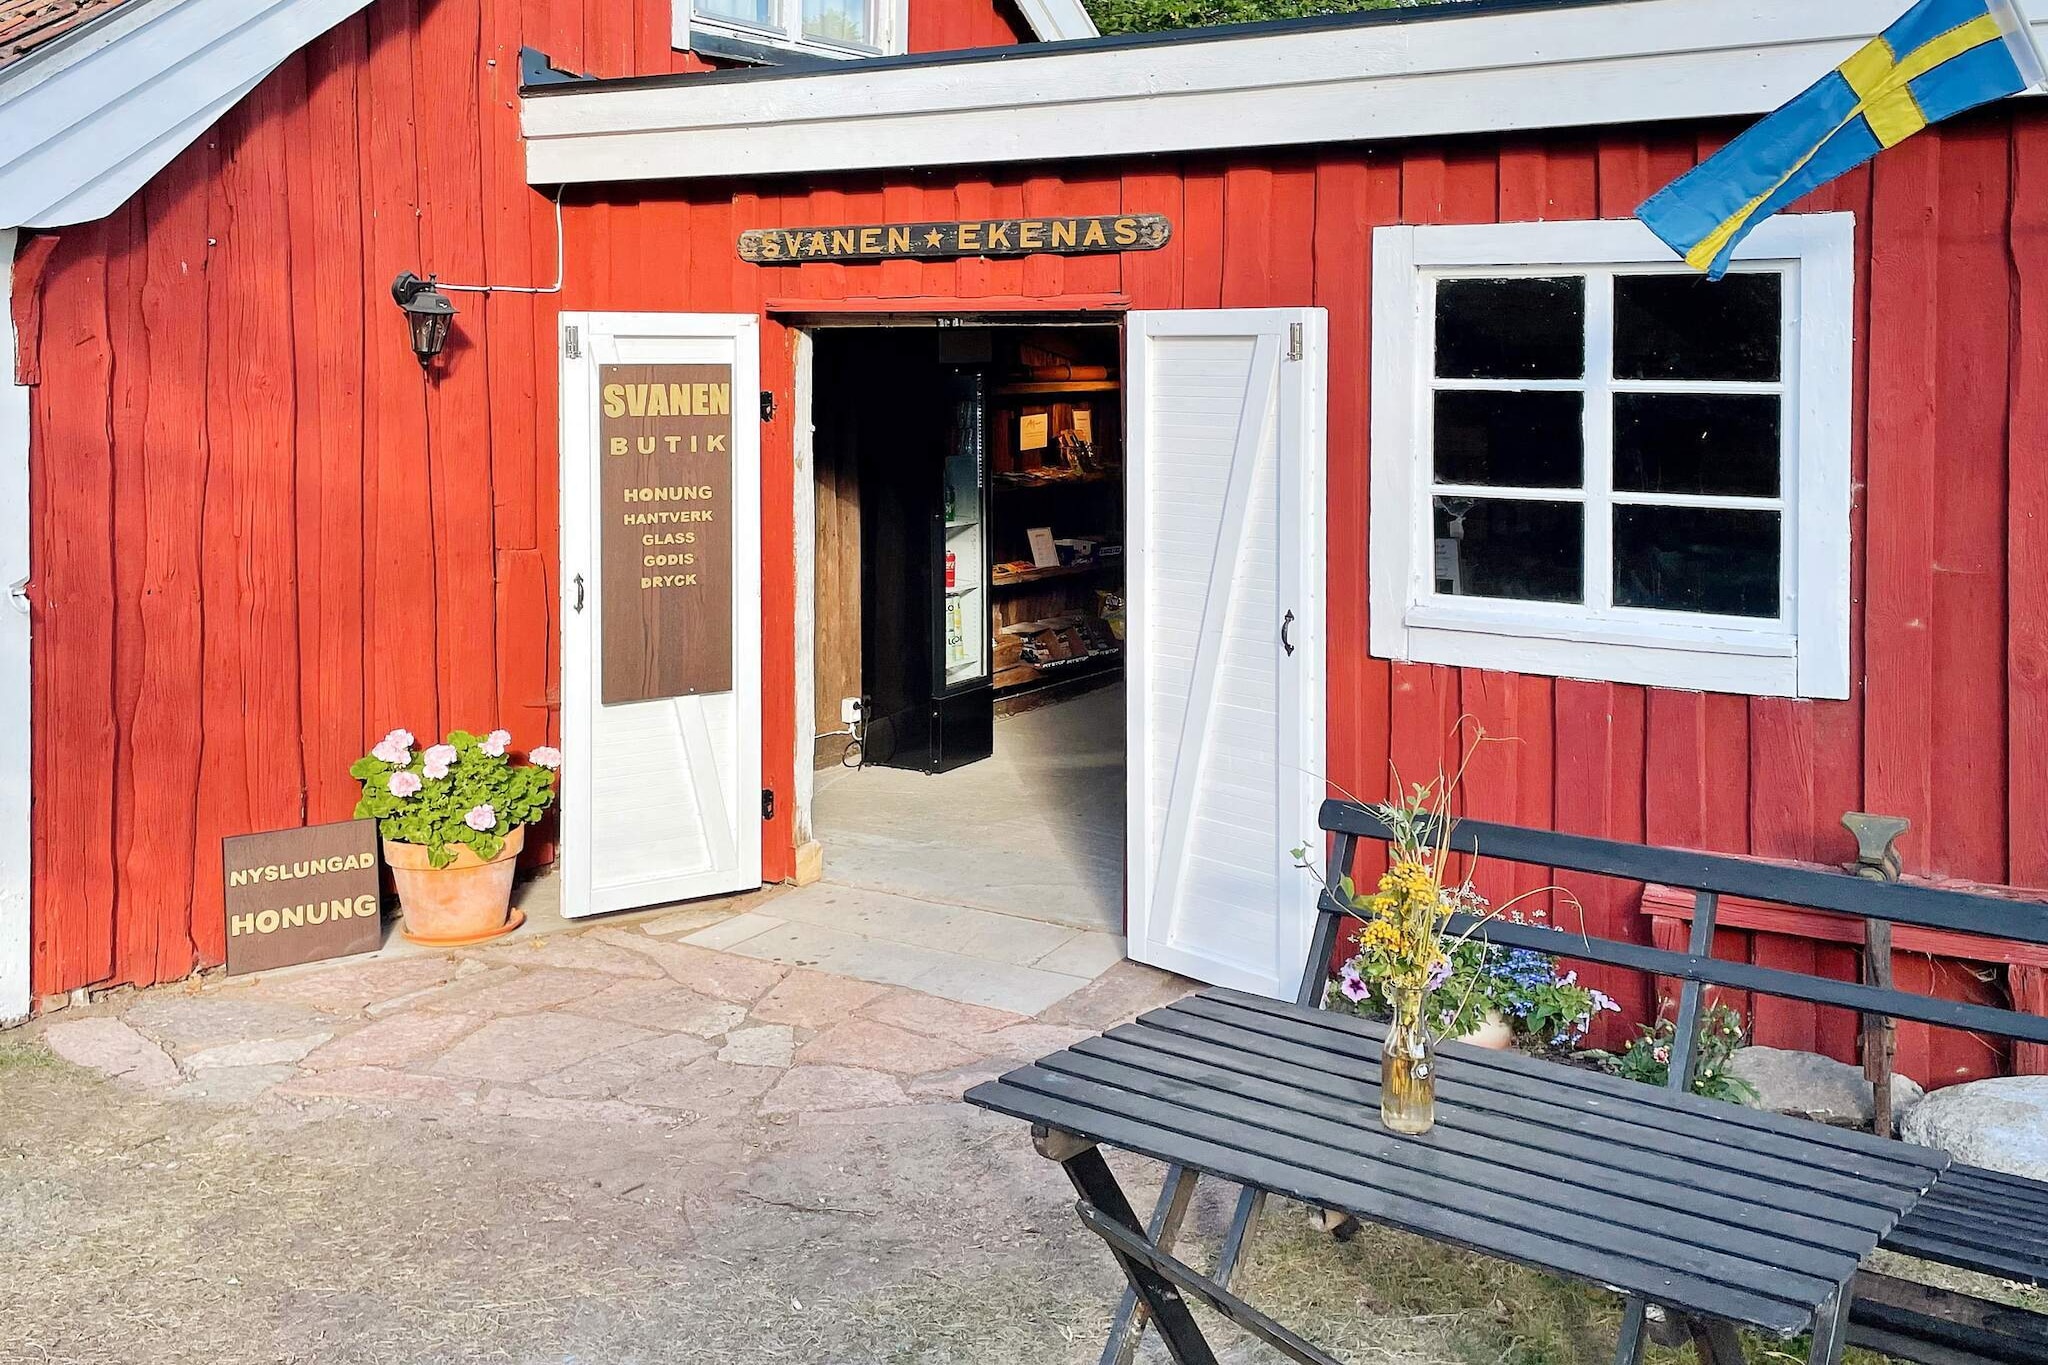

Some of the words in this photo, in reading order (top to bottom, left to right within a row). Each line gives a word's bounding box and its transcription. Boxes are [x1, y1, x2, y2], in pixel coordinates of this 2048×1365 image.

[761, 226, 912, 258] SVANEN
[958, 218, 1138, 250] EKENAS
[603, 383, 730, 419] SVANEN
[610, 434, 726, 456] BUTIK
[624, 485, 713, 503] HONUNG
[623, 510, 714, 526] HANTVERK
[642, 532, 696, 547] GLASS
[643, 553, 695, 568] GODIS
[641, 574, 697, 589] DRYCK
[230, 852, 375, 888] NYSLUNGAD
[231, 894, 377, 937] HONUNG
